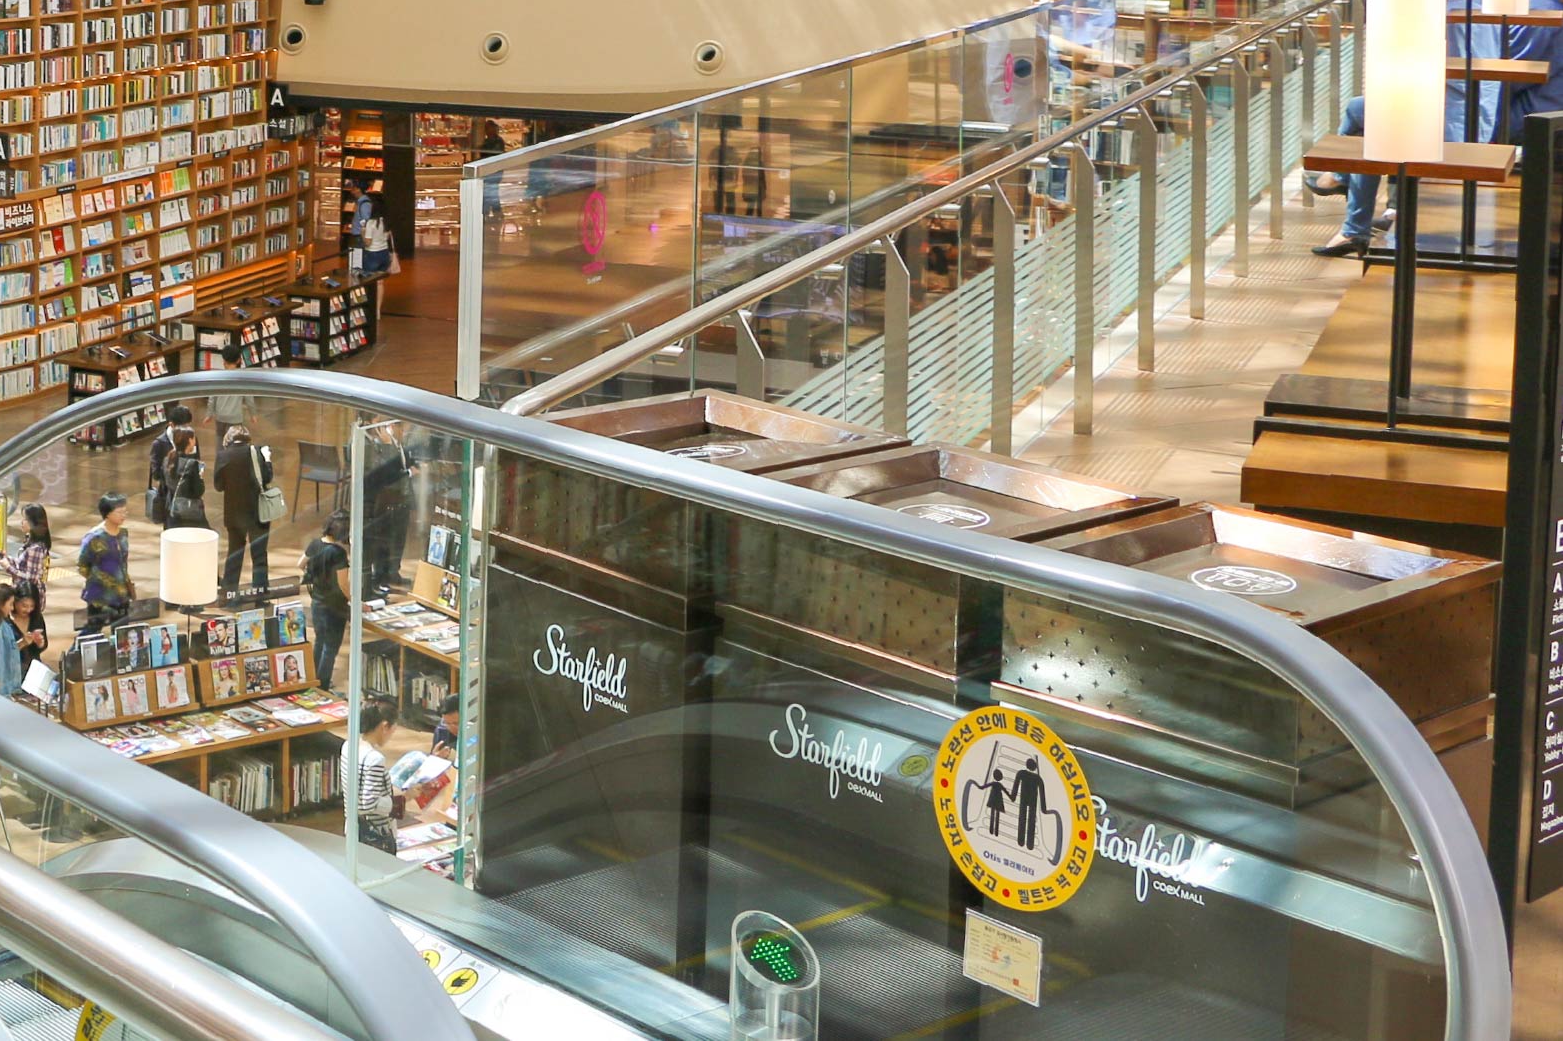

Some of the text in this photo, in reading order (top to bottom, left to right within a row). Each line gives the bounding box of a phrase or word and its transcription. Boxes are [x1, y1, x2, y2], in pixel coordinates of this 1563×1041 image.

[270, 88, 284, 107] A
[268, 118, 287, 130] 소설
[4, 203, 34, 218] 비즈니스
[5, 213, 34, 228] 라이브러리
[1553, 572, 1562, 593] A
[1550, 641, 1559, 662] B
[533, 624, 627, 711] Starfield
[612, 701, 628, 713] MALL
[1546, 711, 1554, 730] C
[769, 703, 883, 799] Starfield
[942, 713, 1088, 821] 노란선 안에 탑승 하십시오
[1543, 779, 1552, 800] D
[940, 798, 998, 892] 노약자 손잡고
[983, 850, 1001, 864] Otis
[1018, 885, 1057, 904] 벨트는
[1067, 845, 1086, 876] 잡고
[1181, 890, 1205, 906] MALL
